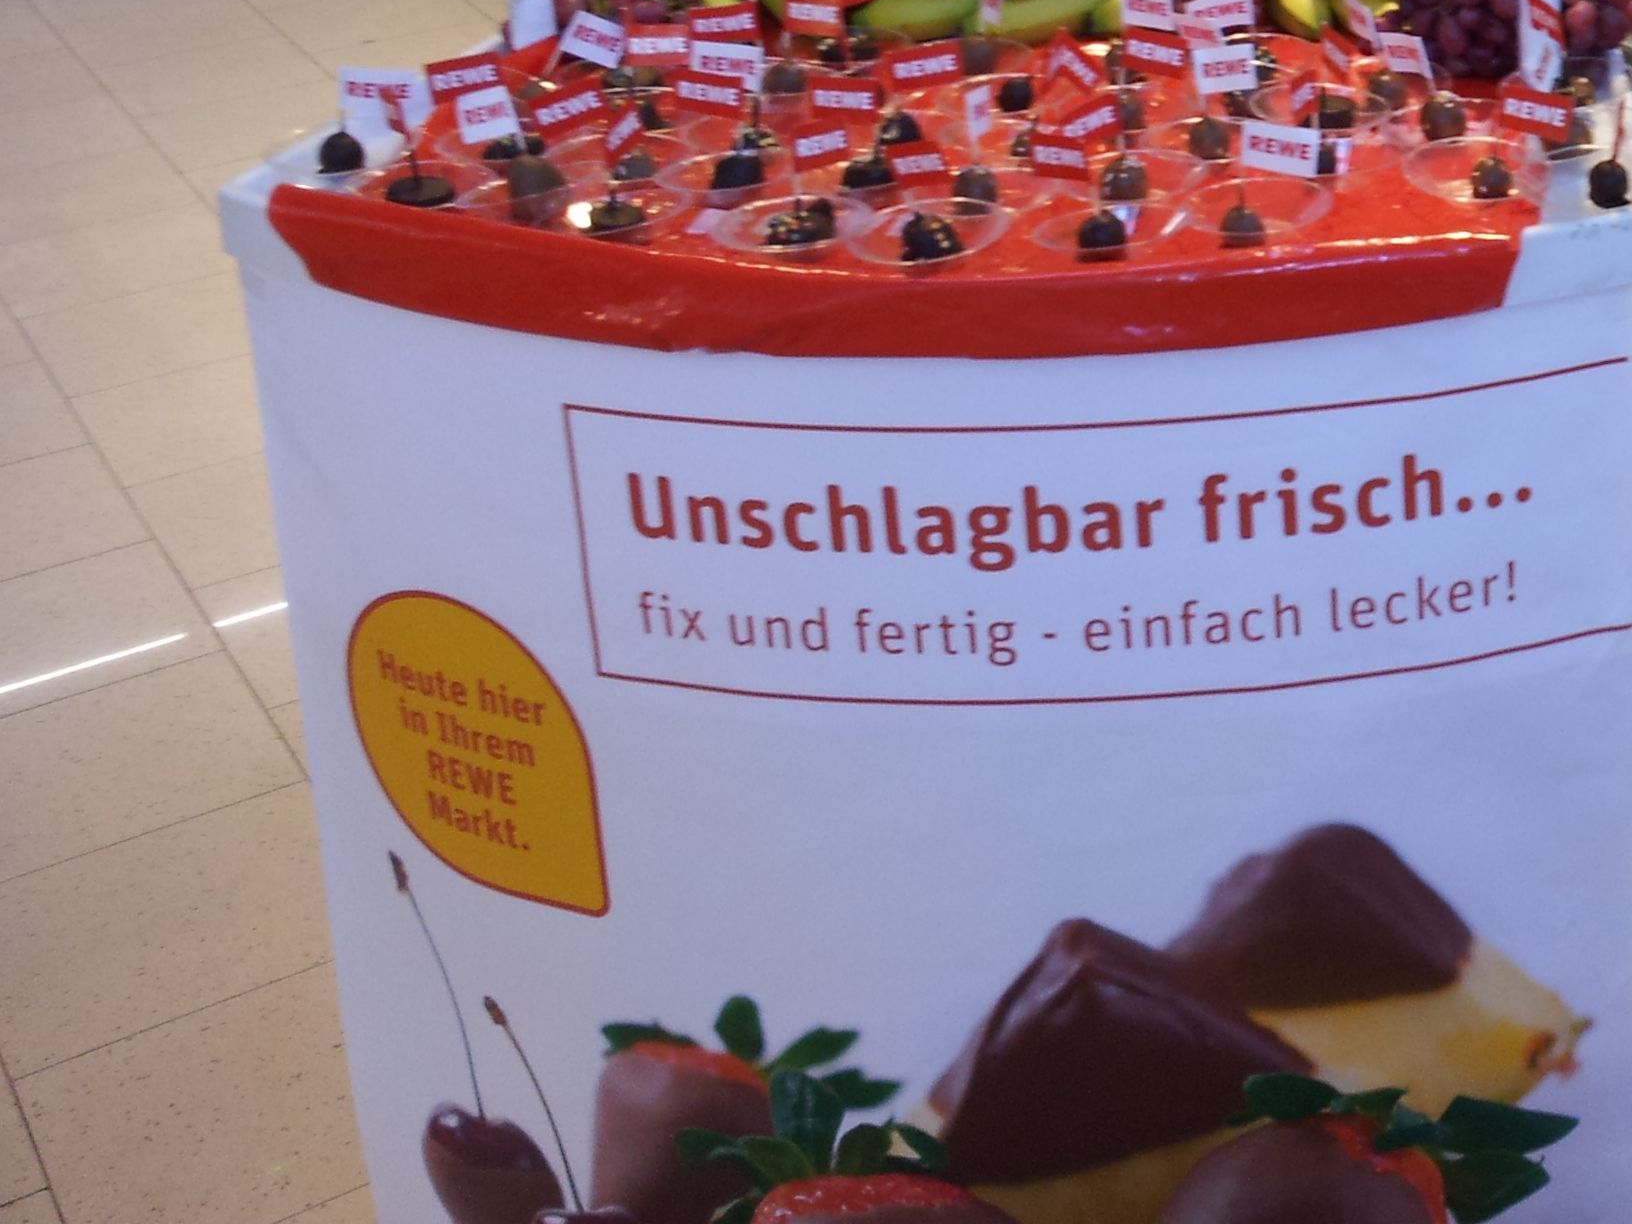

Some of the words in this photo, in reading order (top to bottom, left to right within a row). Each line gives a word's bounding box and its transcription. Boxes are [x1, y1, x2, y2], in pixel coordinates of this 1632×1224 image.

[787, 2, 840, 24] REWE
[574, 25, 622, 53] REWE
[628, 37, 689, 54] REWE
[1127, 38, 1185, 66] REWE
[432, 64, 499, 91] REWE
[702, 55, 756, 75] REWE
[893, 54, 959, 79] REWE
[1203, 57, 1250, 78] REWE
[677, 81, 741, 106] REWE
[813, 88, 876, 110] REWE
[534, 90, 603, 126] REWE
[1062, 104, 1118, 137] REWE
[1504, 97, 1568, 128] REWE
[794, 130, 849, 157] REWE
[1033, 146, 1087, 168] REWE
[1249, 135, 1311, 161] REWE
[893, 153, 946, 175] REWE
[627, 472, 1165, 573] Unschlagbar
[1200, 454, 1531, 542] frisch...
[638, 590, 706, 642] fix
[728, 606, 831, 653] und
[855, 606, 1019, 668] fertig
[1083, 597, 1302, 653] einfach
[1330, 562, 1517, 633] lecker!
[376, 648, 468, 707] Heute
[477, 678, 546, 726] hier
[399, 698, 429, 735] in
[435, 711, 536, 767] Ihrem
[427, 748, 517, 806] REWE
[427, 790, 531, 851] Markt.
